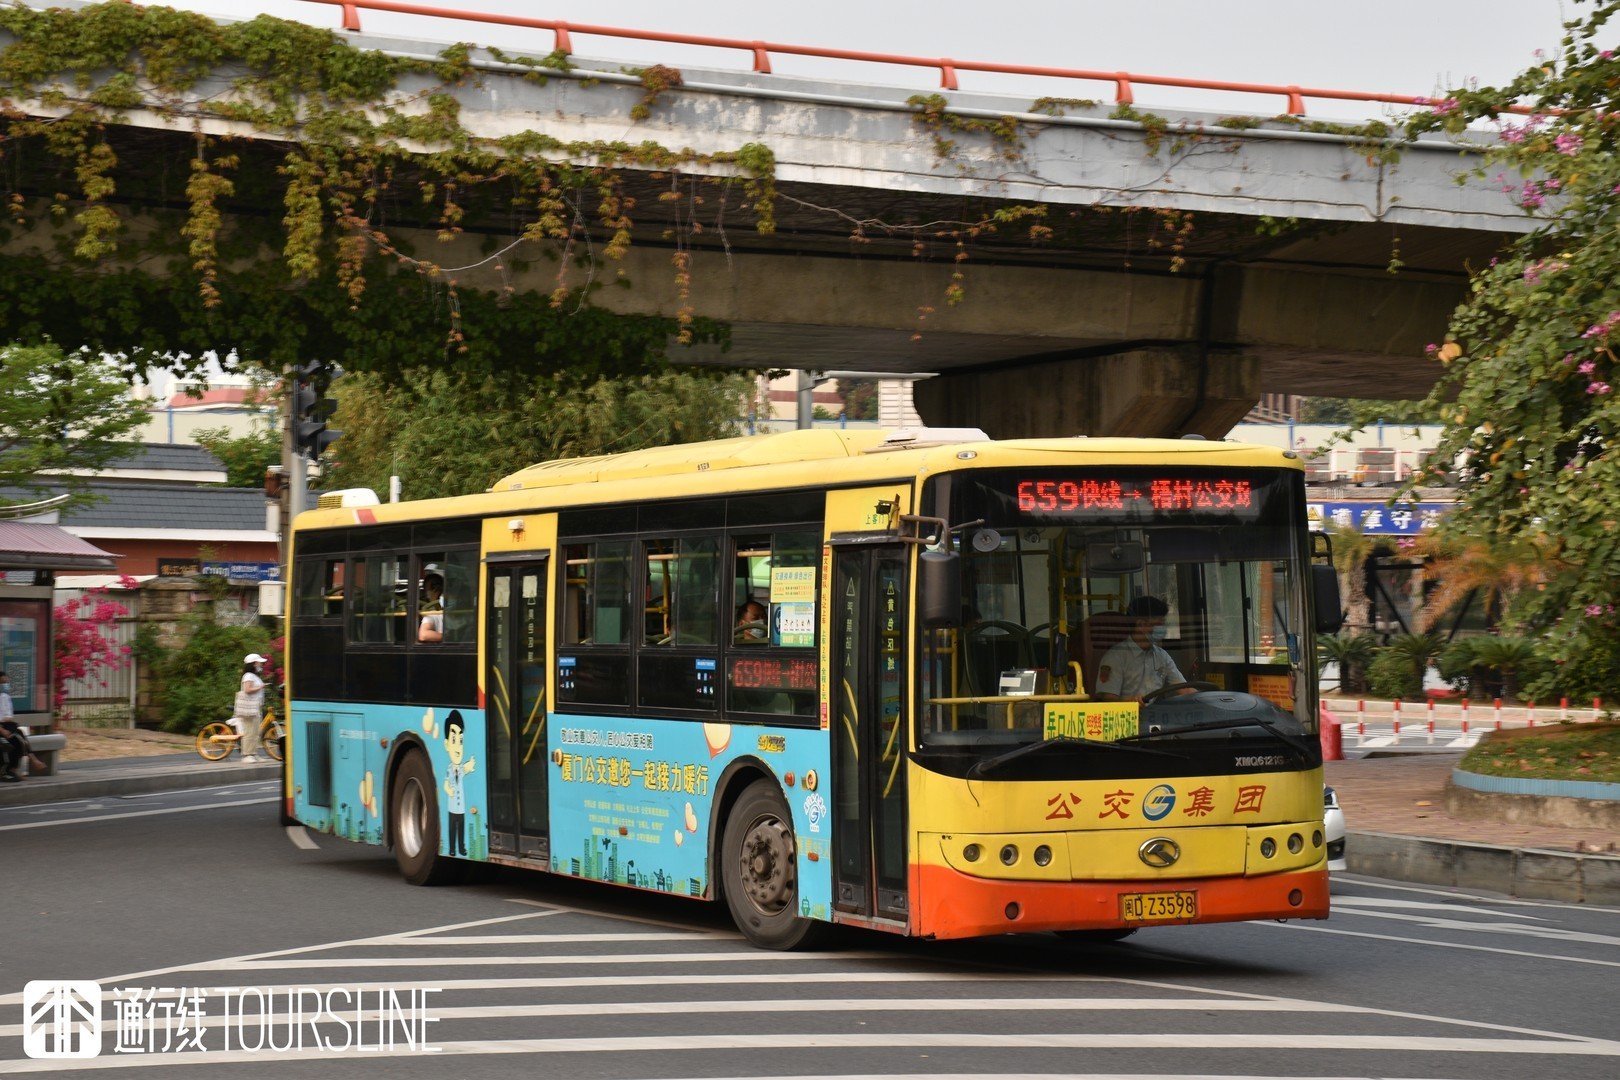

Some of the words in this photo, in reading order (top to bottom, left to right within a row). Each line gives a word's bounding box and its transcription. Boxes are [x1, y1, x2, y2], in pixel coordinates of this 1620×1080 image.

[561, 752, 709, 796] 厦门公交邀您一起接力暖行
